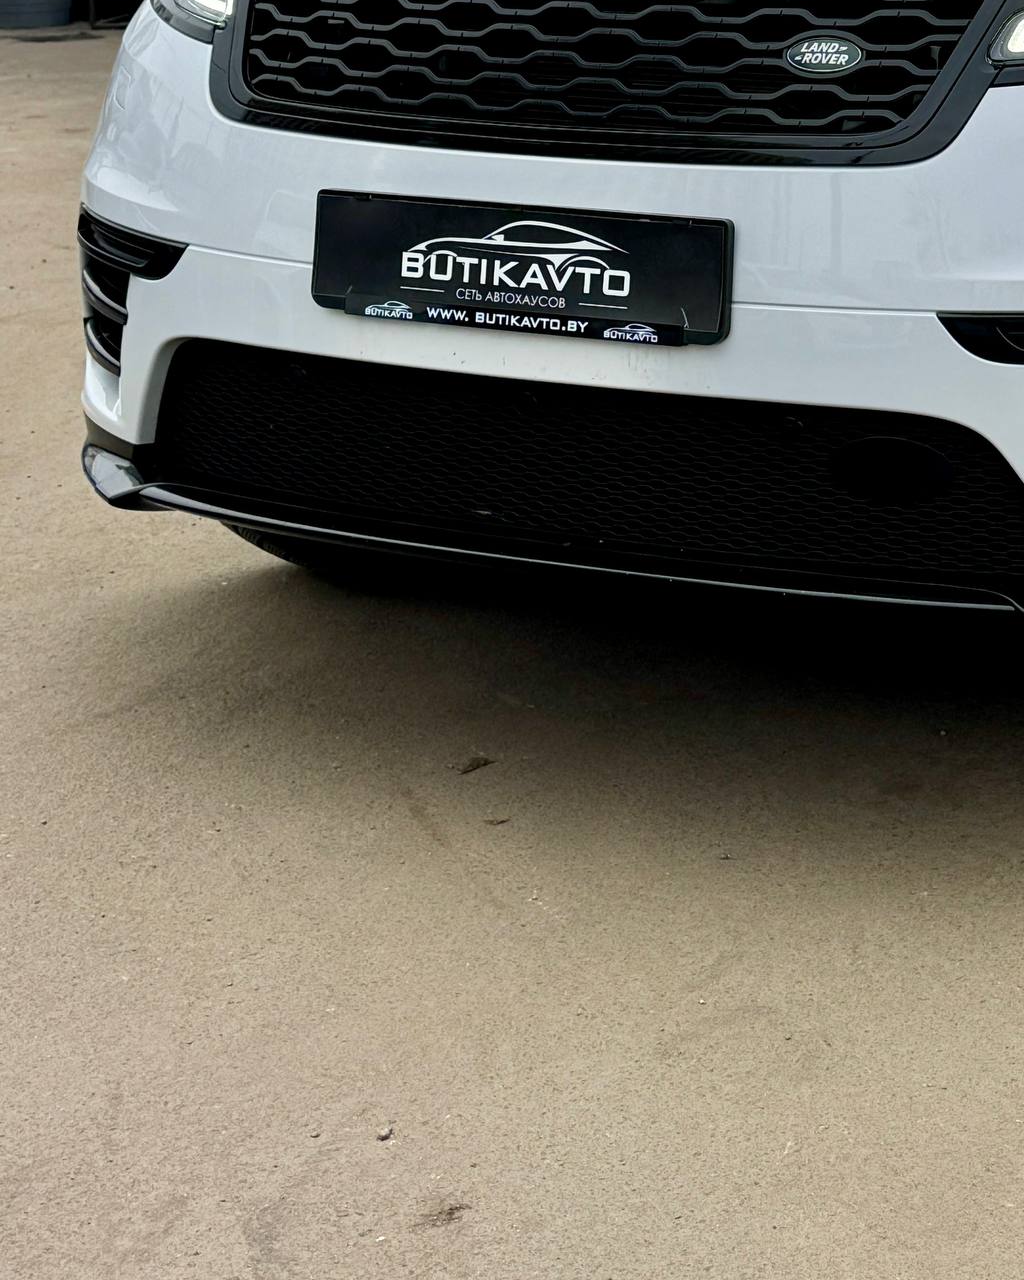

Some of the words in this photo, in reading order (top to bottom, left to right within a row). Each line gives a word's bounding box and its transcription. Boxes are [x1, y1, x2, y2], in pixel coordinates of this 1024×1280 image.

[800, 42, 840, 53] LAND
[801, 53, 849, 65] ROVER
[400, 250, 631, 297] BUTIKAVTO
[456, 287, 483, 301] СЕТЬ
[485, 291, 567, 309] АВТОХАУСОВ
[364, 307, 413, 320] BUTIKAVTO
[426, 306, 469, 322] WWW.
[475, 311, 589, 333] BUTIKAVTO.BY
[603, 330, 658, 343] BUTIKAVTO
